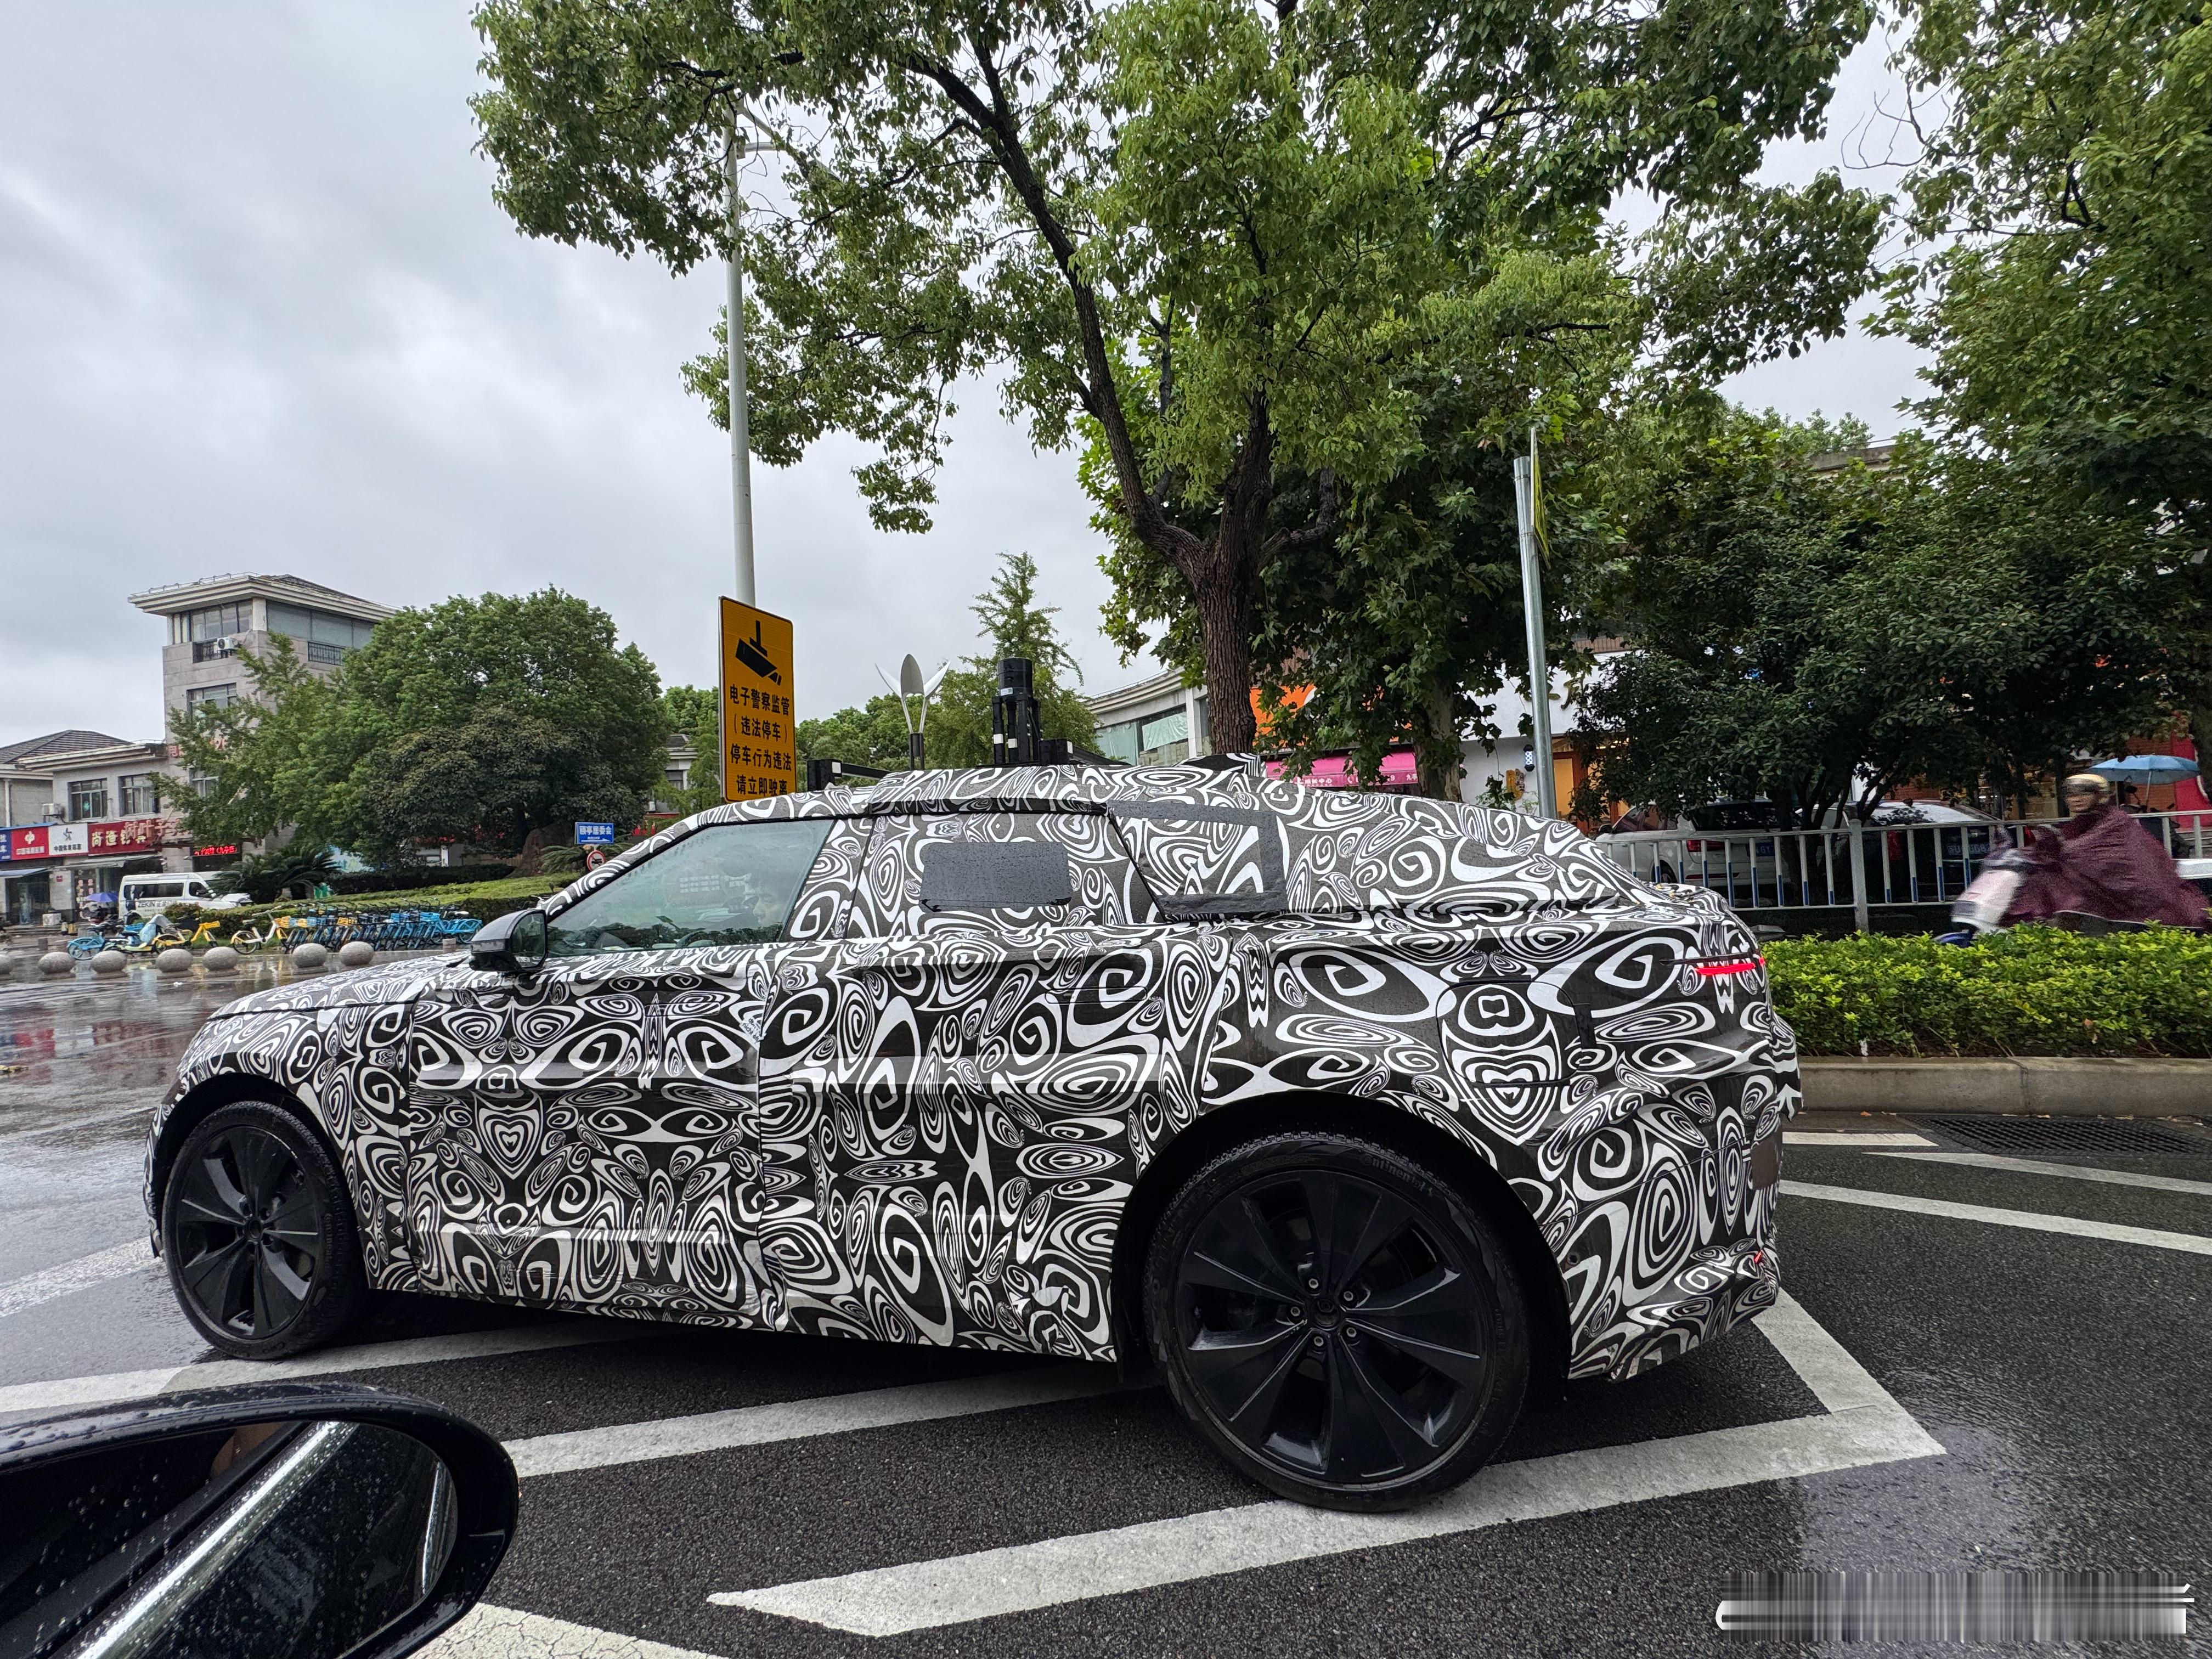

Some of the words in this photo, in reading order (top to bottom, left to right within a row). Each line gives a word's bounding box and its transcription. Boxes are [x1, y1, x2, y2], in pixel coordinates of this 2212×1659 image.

[730, 684, 790, 715] 电子警察监管
[730, 743, 792, 771] 停车行为违法
[736, 774, 787, 796] 请立即驶离
